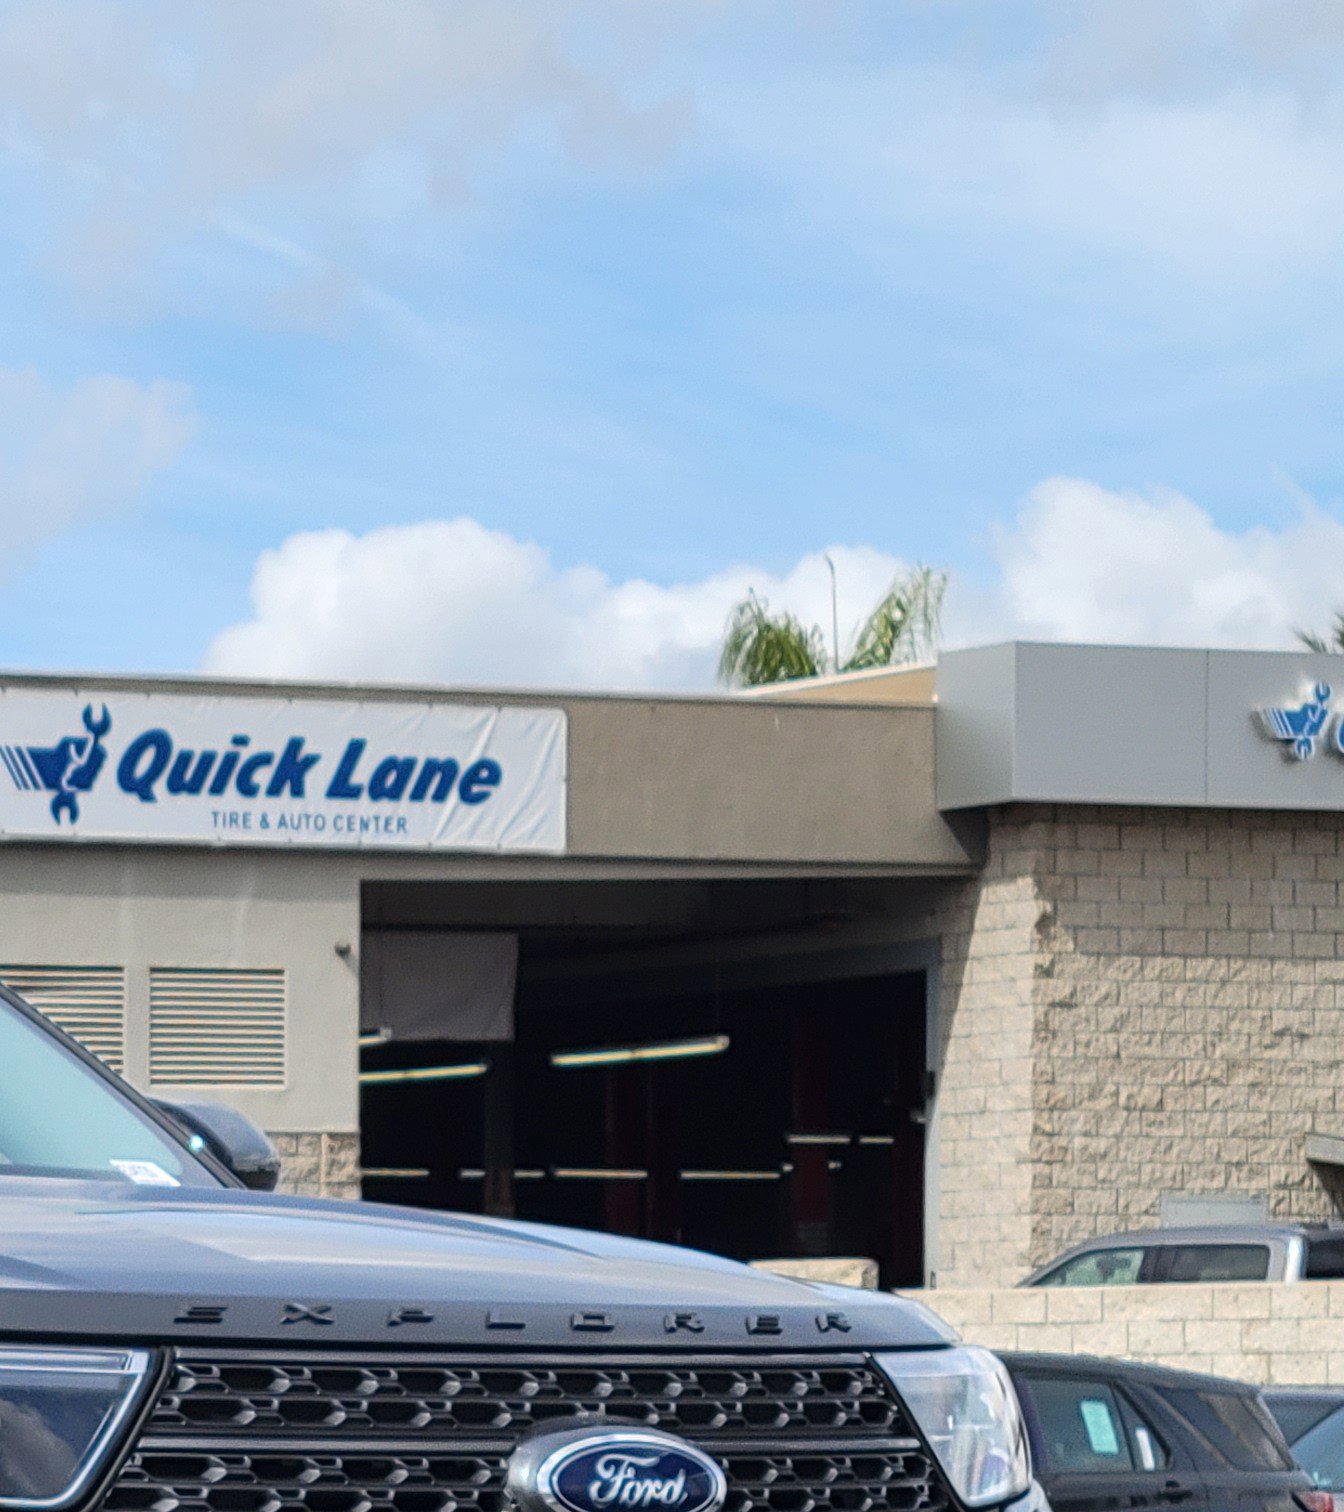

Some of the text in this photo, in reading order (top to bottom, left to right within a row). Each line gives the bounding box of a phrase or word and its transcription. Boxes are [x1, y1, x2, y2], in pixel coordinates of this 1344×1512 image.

[117, 728, 503, 806] Quick Lane
[212, 811, 407, 834] TIRE & AUTO CENTER
[173, 1303, 853, 1335] EXPLORER
[588, 1453, 689, 1508] Ford
